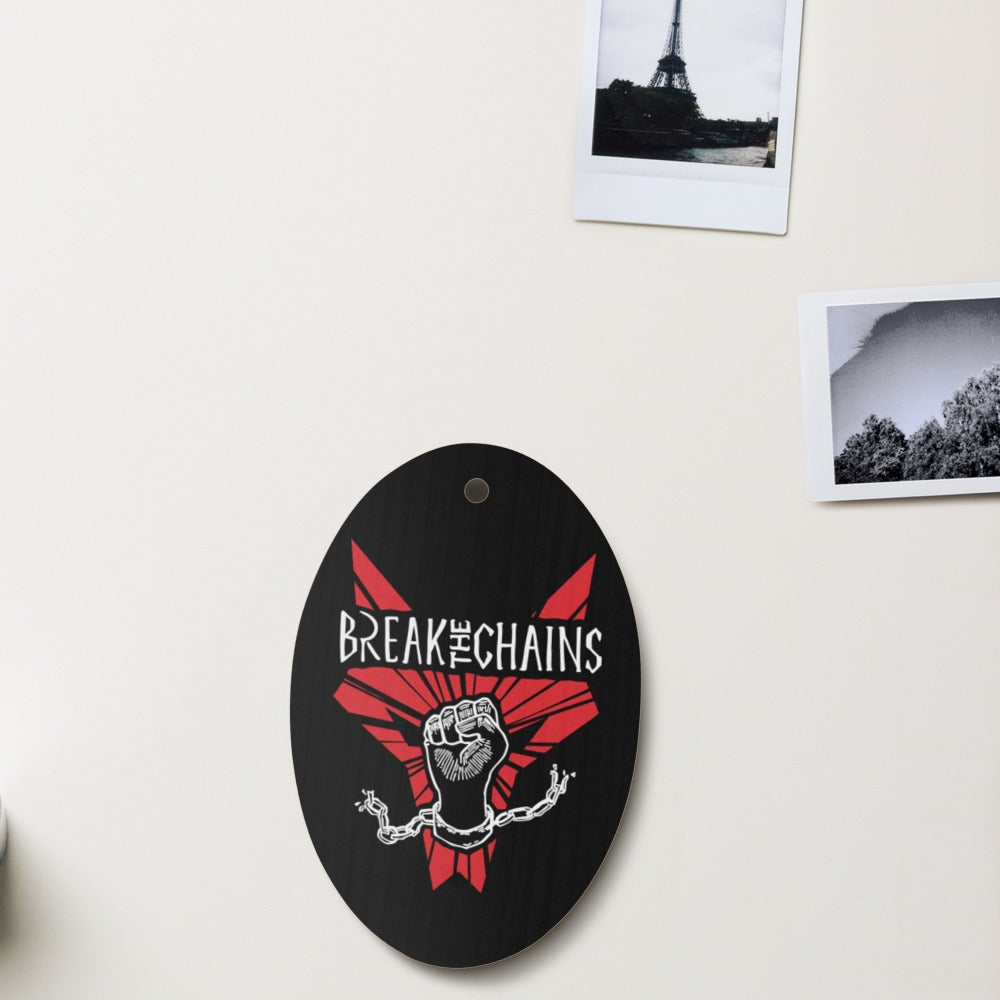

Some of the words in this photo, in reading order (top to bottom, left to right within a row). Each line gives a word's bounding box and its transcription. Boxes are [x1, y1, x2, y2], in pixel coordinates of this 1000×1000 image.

[339, 610, 448, 666] BREAK
[449, 618, 472, 669] THE
[473, 622, 603, 674] CHAINS
